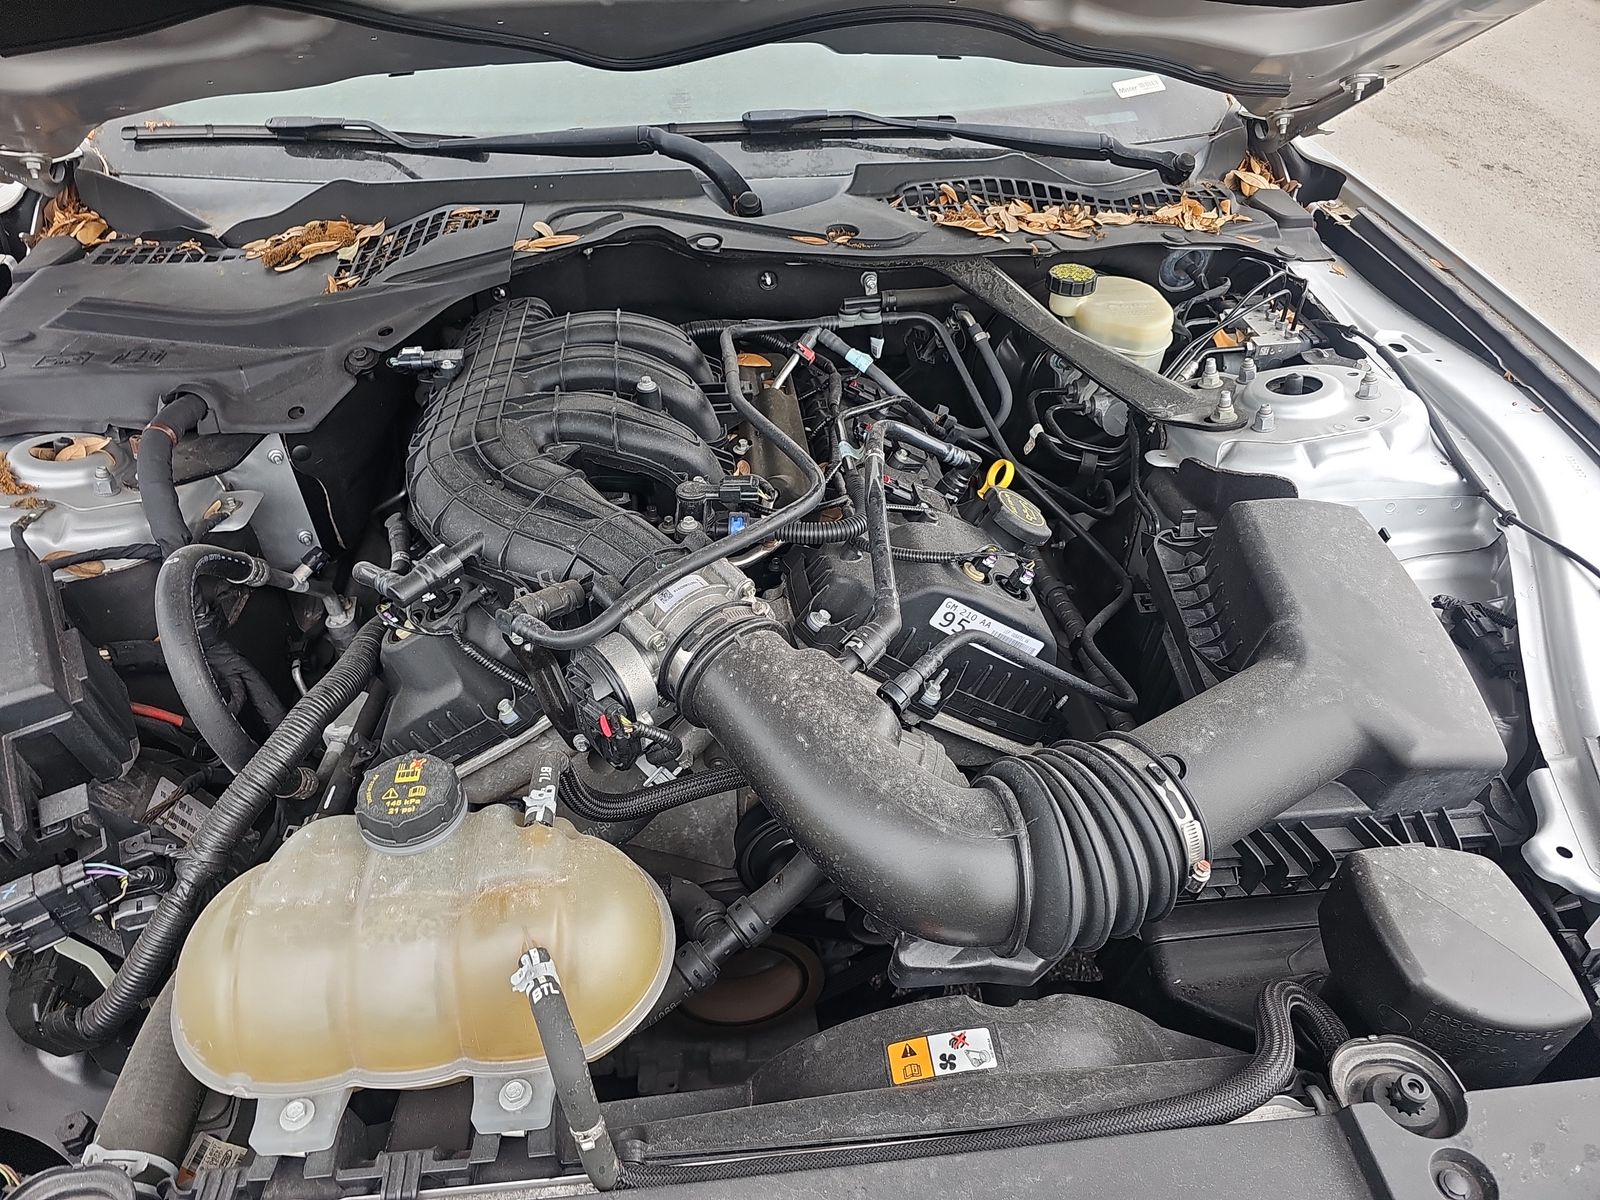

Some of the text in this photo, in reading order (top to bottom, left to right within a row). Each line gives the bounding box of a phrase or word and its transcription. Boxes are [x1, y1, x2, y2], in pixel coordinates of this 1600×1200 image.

[938, 611, 971, 634] 95
[945, 601, 992, 629] GM 210 AA
[538, 766, 552, 782] BTL
[401, 806, 416, 815] psi
[403, 798, 421, 806] kPa
[531, 981, 560, 1005] BTL
